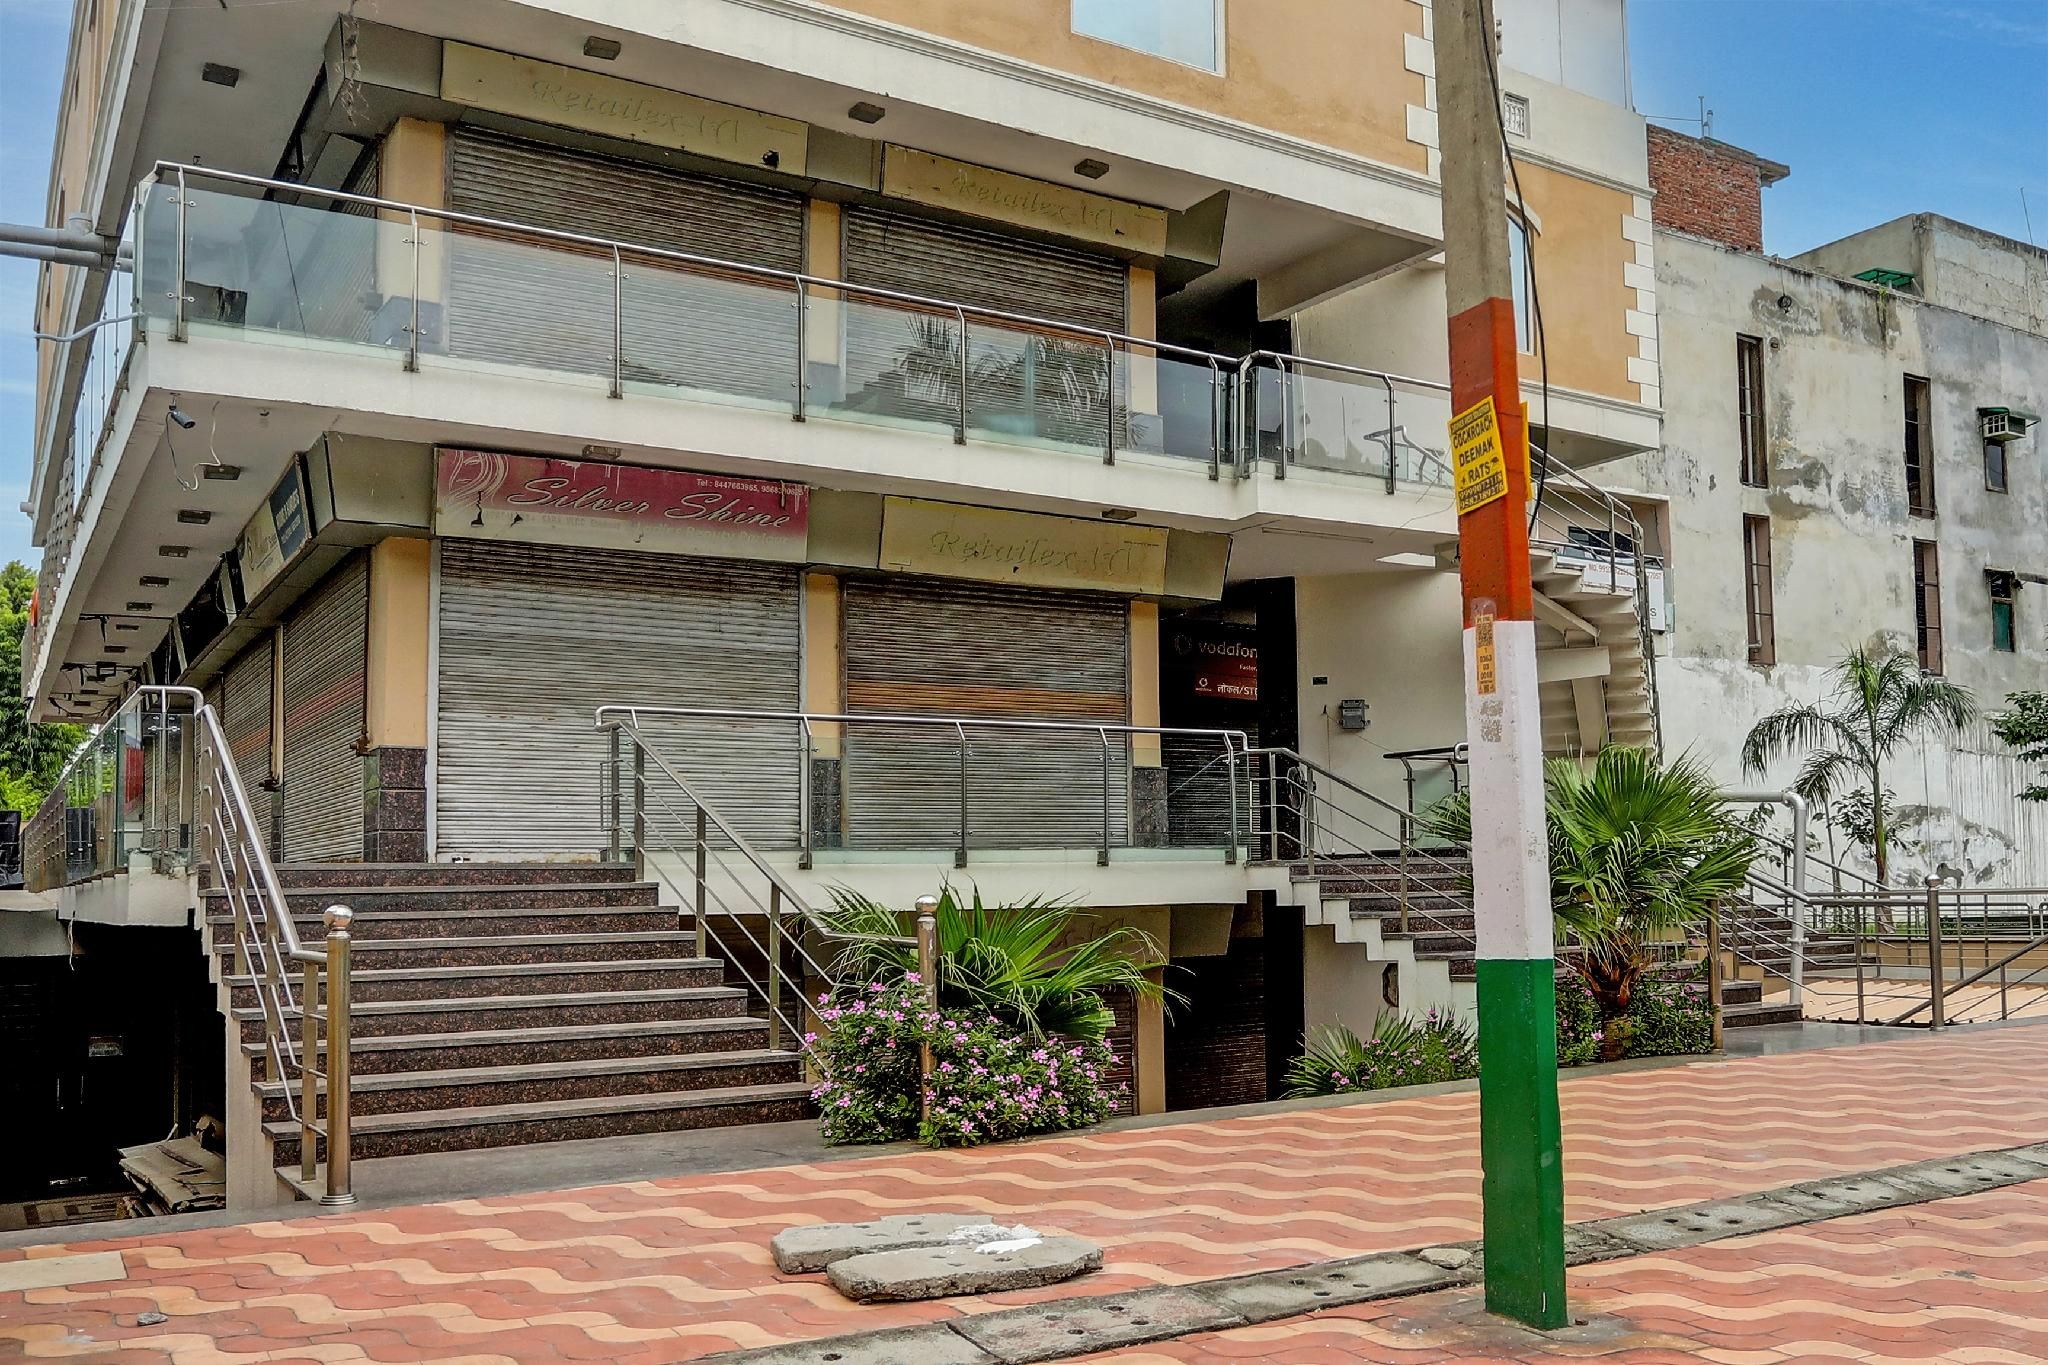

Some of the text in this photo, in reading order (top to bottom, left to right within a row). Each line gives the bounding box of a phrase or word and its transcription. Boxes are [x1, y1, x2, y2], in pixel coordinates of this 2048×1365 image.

[1453, 413, 1494, 449] COCKROACH
[1459, 437, 1494, 466] DEEMAK
[1468, 462, 1491, 482] RATS
[506, 477, 793, 529] Silver Shine
